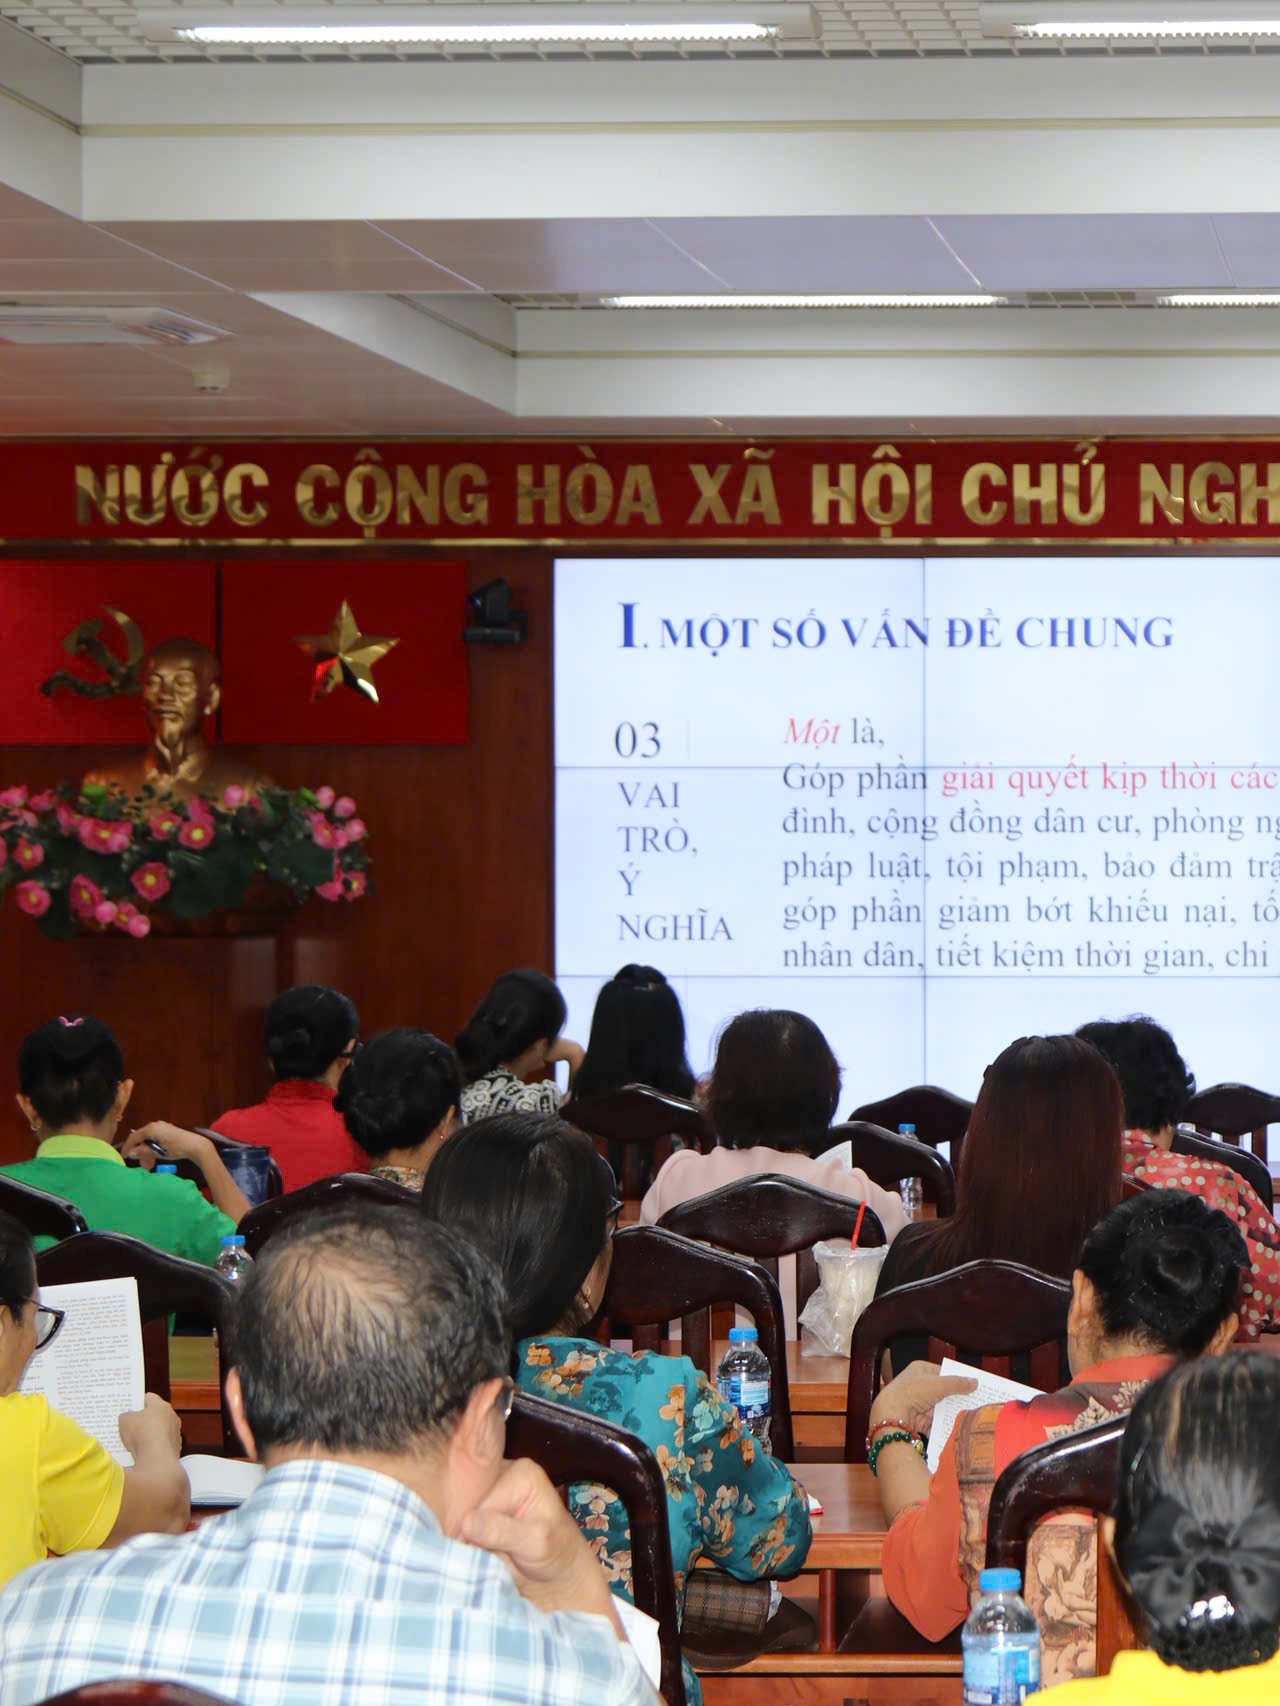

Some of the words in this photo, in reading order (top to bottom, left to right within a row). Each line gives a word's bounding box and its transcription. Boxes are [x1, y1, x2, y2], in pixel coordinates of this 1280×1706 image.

[75, 446, 269, 526] NƯỚC
[295, 447, 489, 538] CỘNG
[516, 444, 662, 526] HÒA
[687, 446, 781, 525] XÃ
[811, 443, 933, 538] HỘI
[960, 441, 1106, 526] CHỦ
[617, 601, 649, 649] I.
[660, 612, 759, 657] MỘT
[772, 607, 827, 649] SỐ
[841, 607, 930, 649] VẤN
[946, 607, 1001, 649] ĐỀ
[1015, 616, 1175, 649] CHUNG
[614, 721, 662, 759] 03
[784, 717, 840, 748] Một
[851, 717, 884, 746] là,
[783, 763, 844, 797] Góp
[858, 754, 928, 797] phần
[941, 762, 994, 797] giải
[1008, 754, 1088, 797] quyết
[1102, 762, 1147, 797] kịp
[1161, 761, 1217, 790] thời
[1230, 762, 1278, 790] các
[617, 781, 680, 809] VAI
[617, 818, 698, 856] TRÒ,
[782, 807, 855, 838] đình,
[867, 808, 938, 841] cộng
[949, 801, 1022, 840] đồng
[1034, 807, 1085, 834] dân
[1098, 811, 1141, 838] cư,
[1153, 807, 1244, 841] phòng
[618, 862, 641, 897] Ý
[783, 852, 852, 886] pháp
[869, 852, 930, 884] luật,
[946, 853, 983, 883] tội
[999, 852, 1088, 886] phạm,
[1105, 851, 1155, 879] bảo
[1170, 851, 1231, 879] đảm
[617, 907, 735, 942] NGHĨA
[783, 897, 836, 930] góp
[852, 889, 922, 930] phần
[939, 896, 1010, 930] giảm
[1026, 896, 1072, 923] bớt
[1089, 889, 1167, 923] khiếu
[1184, 897, 1236, 928] nại,
[1252, 889, 1280, 923] tố
[783, 941, 852, 968] nhân
[864, 941, 924, 971] dân,
[936, 934, 981, 968] tiết
[993, 941, 1063, 972] kiệm
[1075, 941, 1131, 968] thời
[1144, 943, 1214, 975] gian,
[1225, 941, 1268, 968] chi
